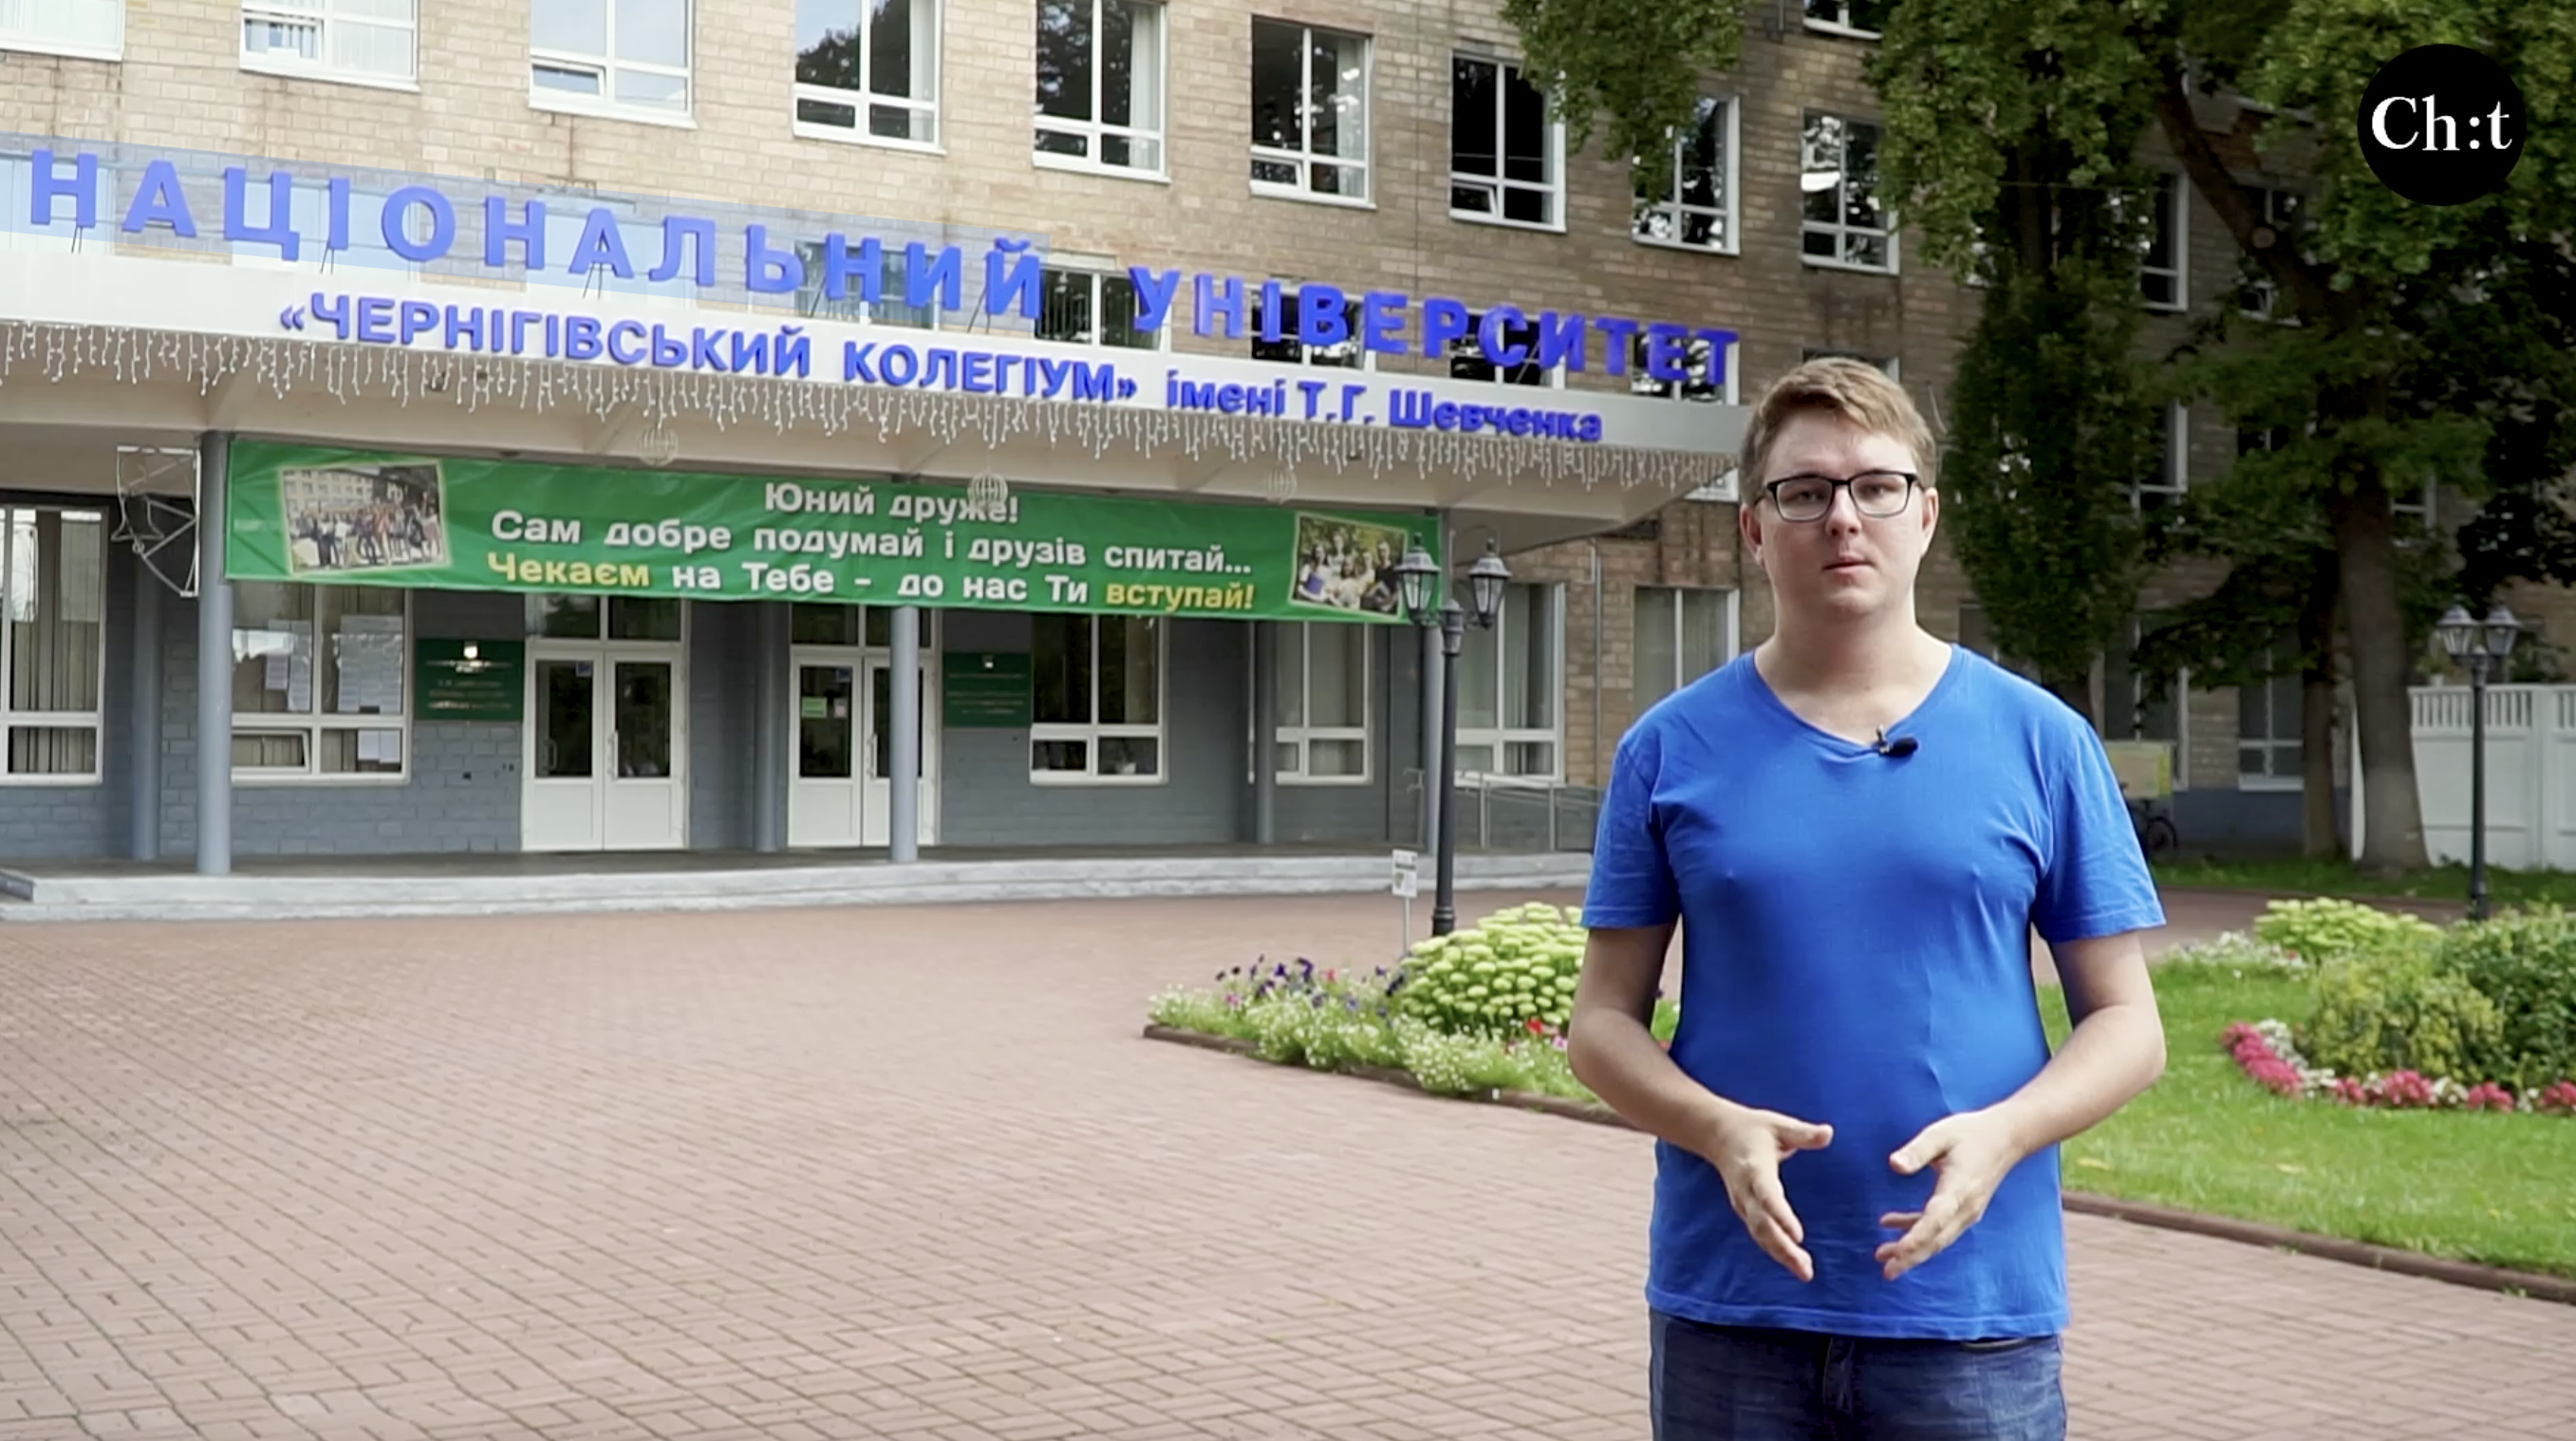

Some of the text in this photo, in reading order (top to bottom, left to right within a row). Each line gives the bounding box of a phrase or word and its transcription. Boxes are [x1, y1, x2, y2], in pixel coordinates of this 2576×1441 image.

[30, 149, 1739, 385] НАЦІОНАЛЬНИЙ УНІВЕРСИТЕТ
[280, 292, 811, 379] «ЧЕРНІГІВСЬКИЙ
[844, 341, 1138, 402] КОЛЕГІУМ»
[1166, 370, 1286, 416] імені
[1389, 388, 1603, 442] Шевченка
[764, 482, 1018, 525] Юний друже!
[492, 510, 1252, 575] Сам добре подумай і друзів спитай...
[487, 552, 649, 587] Чекаєм
[672, 564, 721, 590] на
[741, 561, 834, 594] Тебе
[897, 576, 943, 600] до
[962, 577, 1027, 602] нас
[1046, 575, 1088, 605] Ти
[1106, 578, 1254, 609] вступай!
